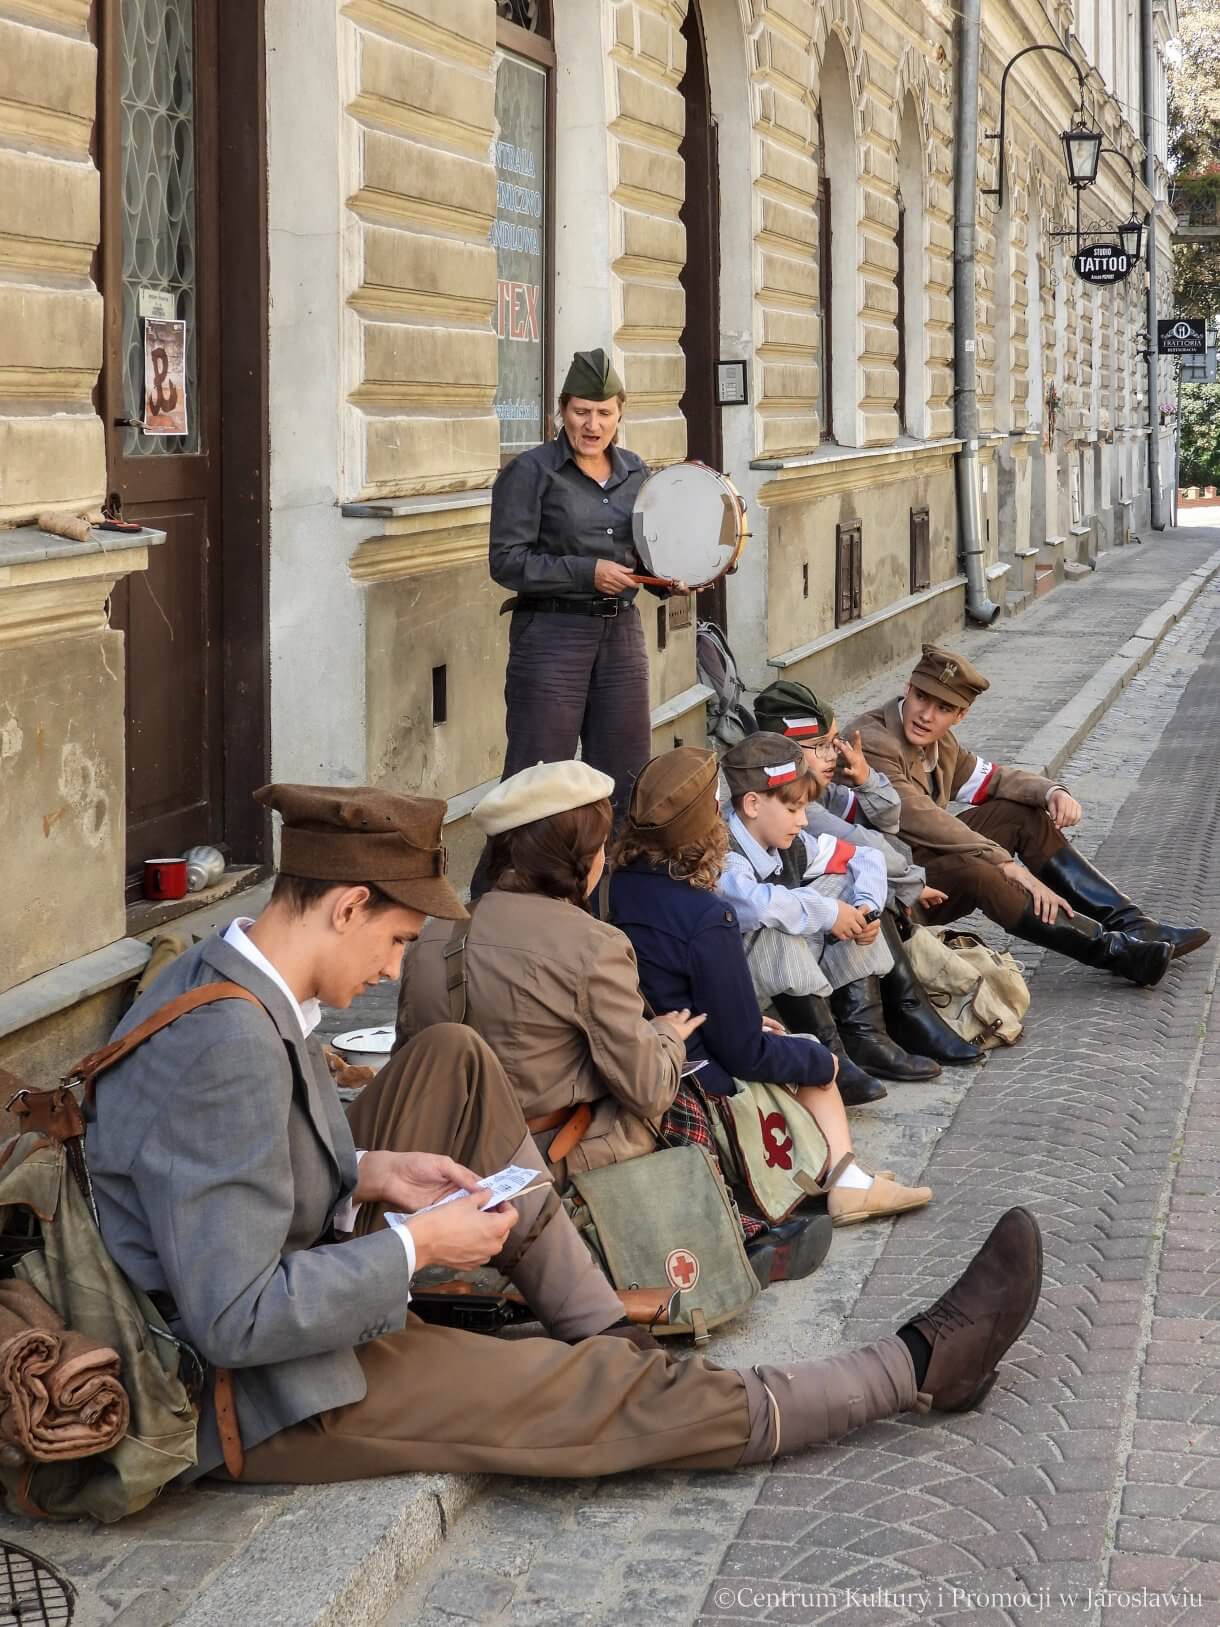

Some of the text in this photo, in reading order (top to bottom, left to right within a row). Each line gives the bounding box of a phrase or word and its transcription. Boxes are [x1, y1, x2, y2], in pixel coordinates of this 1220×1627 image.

[491, 141, 535, 178] NTRALA
[1093, 248, 1112, 256] STUDIO
[1078, 256, 1127, 273] TATTOO
